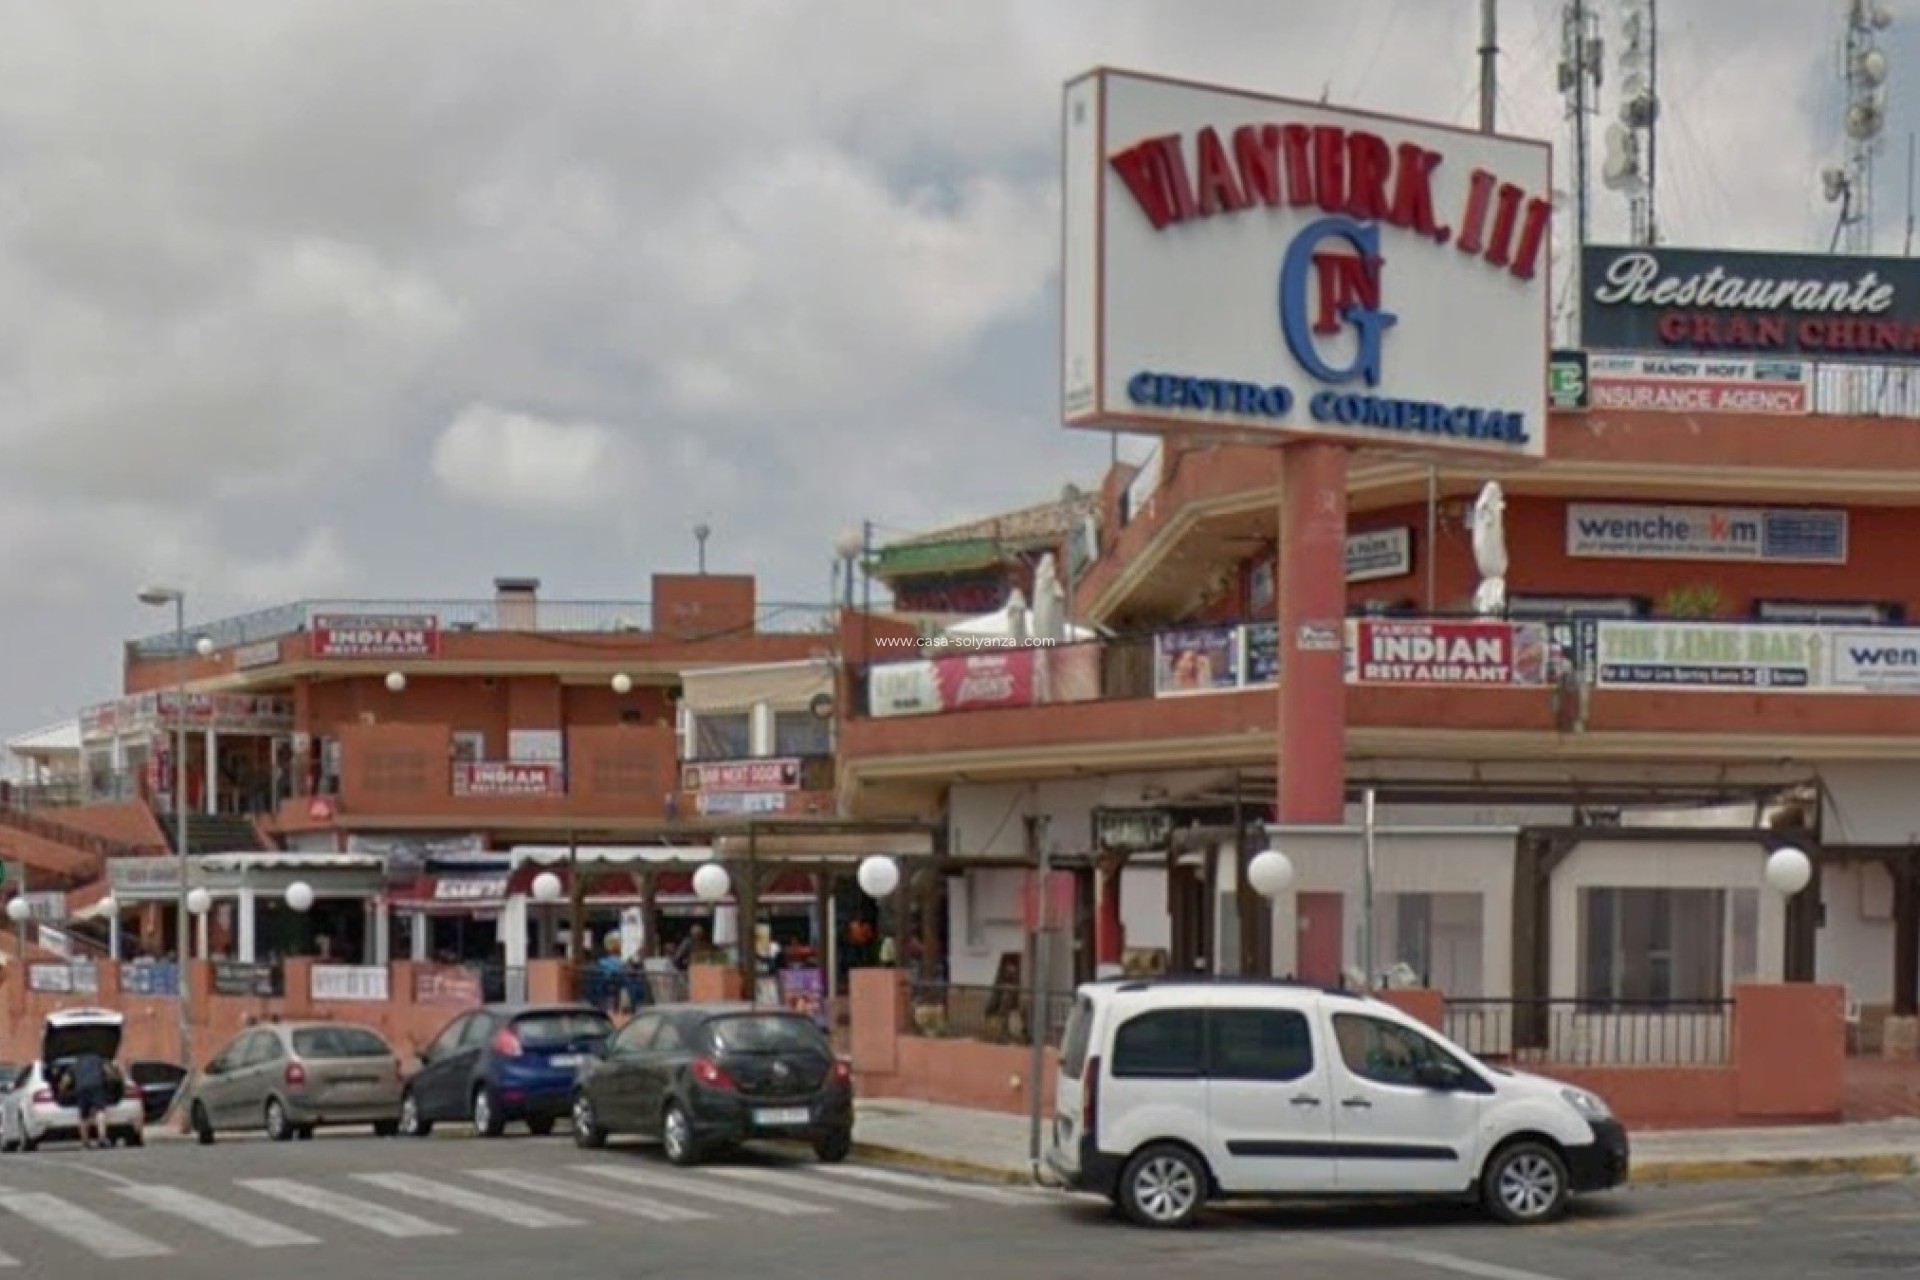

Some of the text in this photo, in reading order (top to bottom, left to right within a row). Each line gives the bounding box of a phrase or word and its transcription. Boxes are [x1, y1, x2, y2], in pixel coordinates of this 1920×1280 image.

[1594, 253, 1895, 312] Restaurante
[1659, 314, 1785, 345] GRAN
[1128, 371, 1530, 444] CENTRO COMERCIAL
[1373, 636, 1502, 662] INDIAN
[1365, 664, 1509, 680] RESTAURANT
